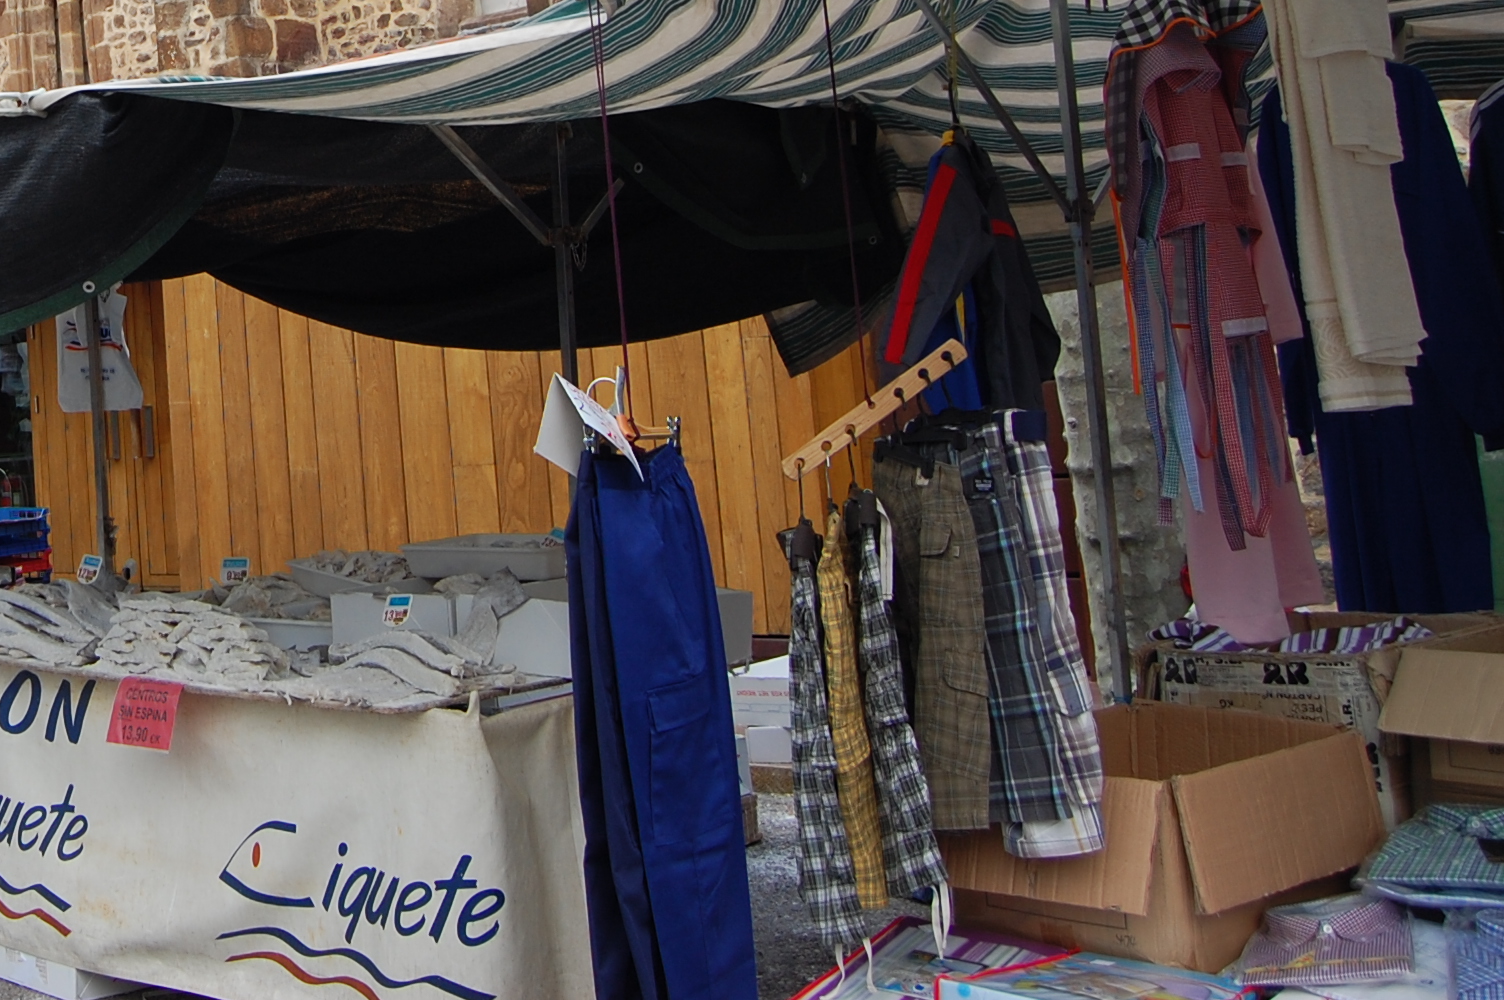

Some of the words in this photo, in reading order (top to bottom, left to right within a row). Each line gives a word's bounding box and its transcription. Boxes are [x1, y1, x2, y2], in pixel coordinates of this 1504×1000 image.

[125, 687, 169, 704] CENTROS
[118, 705, 133, 718] SIN
[134, 706, 168, 722] ESPINA
[122, 725, 149, 743] 13,90
[218, 820, 506, 947] Ciquete
